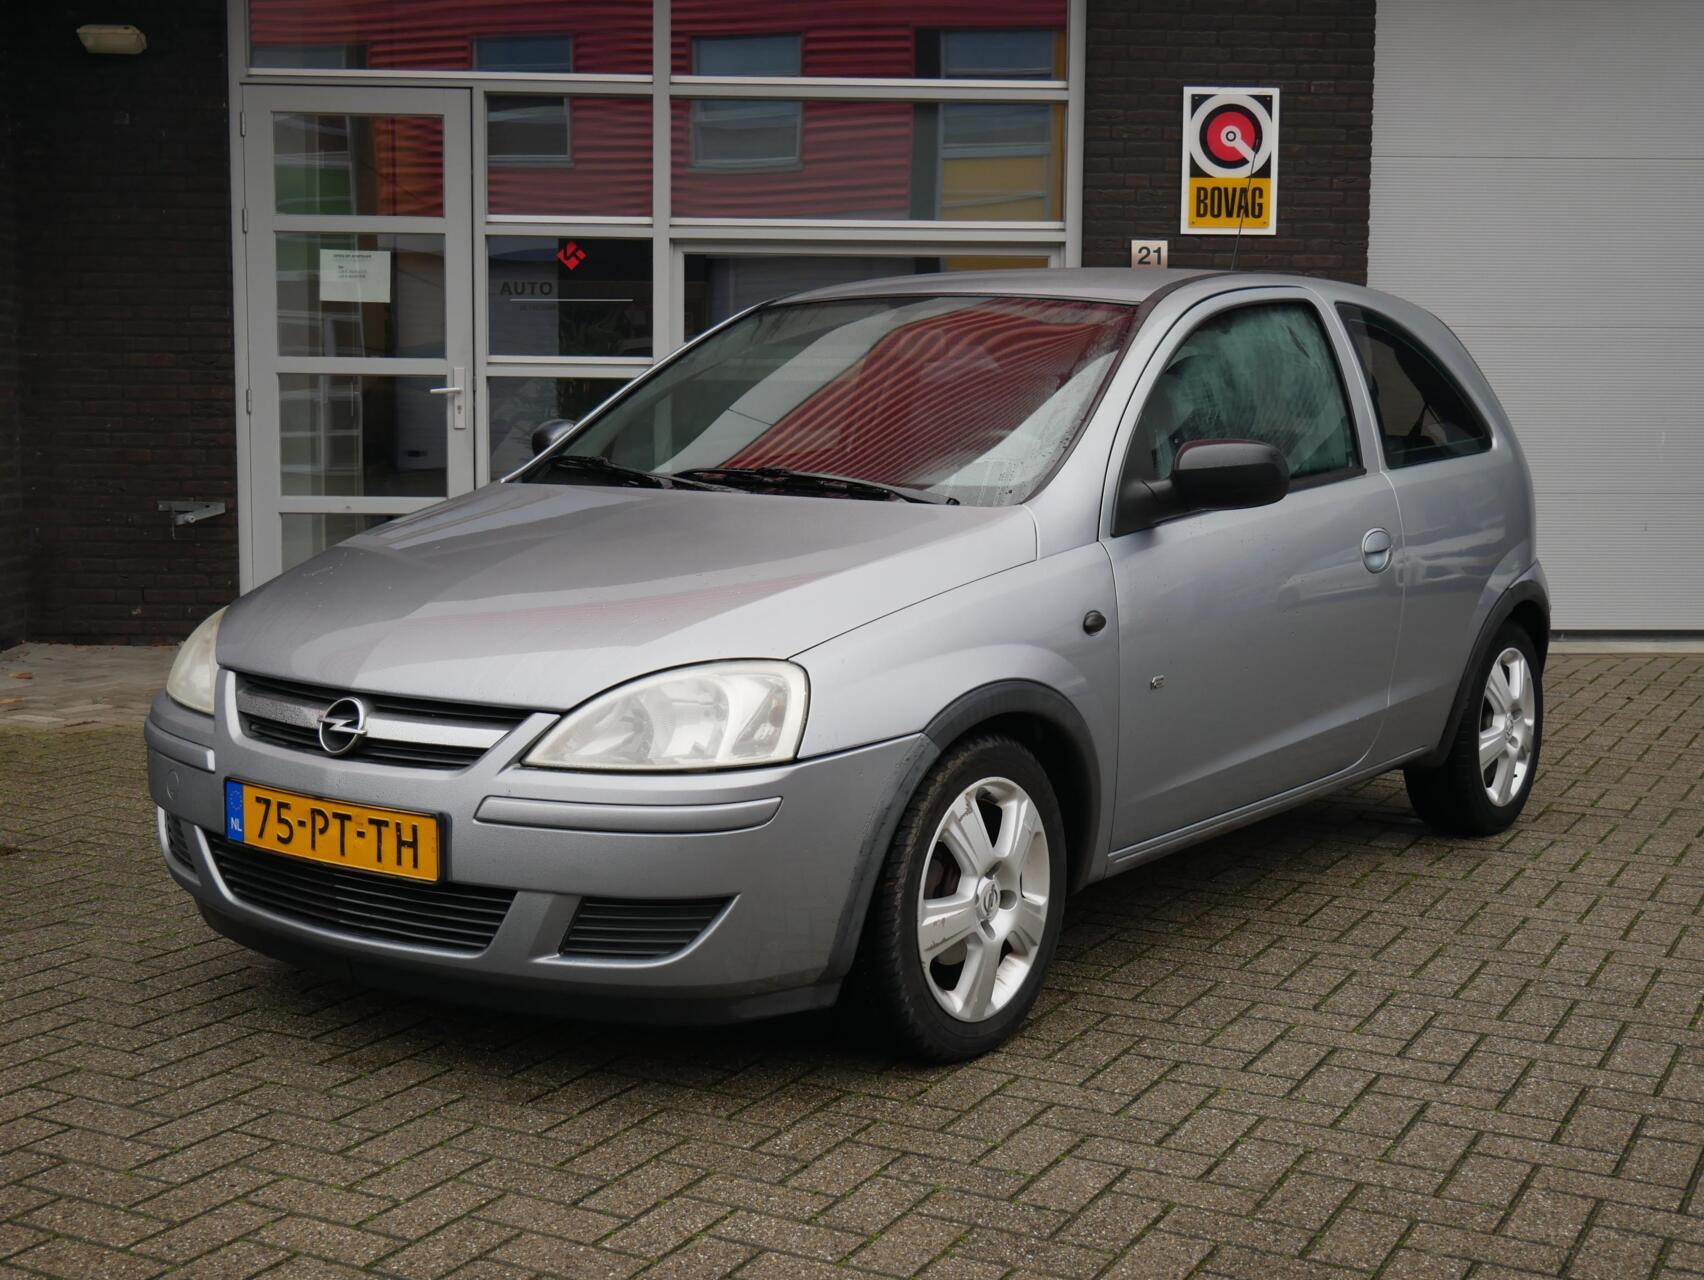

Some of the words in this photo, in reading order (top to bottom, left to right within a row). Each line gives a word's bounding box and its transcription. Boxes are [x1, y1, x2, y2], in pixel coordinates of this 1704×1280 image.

[1196, 186, 1263, 219] BOVAG
[1137, 246, 1162, 265] 21
[500, 281, 553, 295] AUTO
[230, 816, 243, 832] NL
[255, 796, 418, 869] 75-PT-TH
